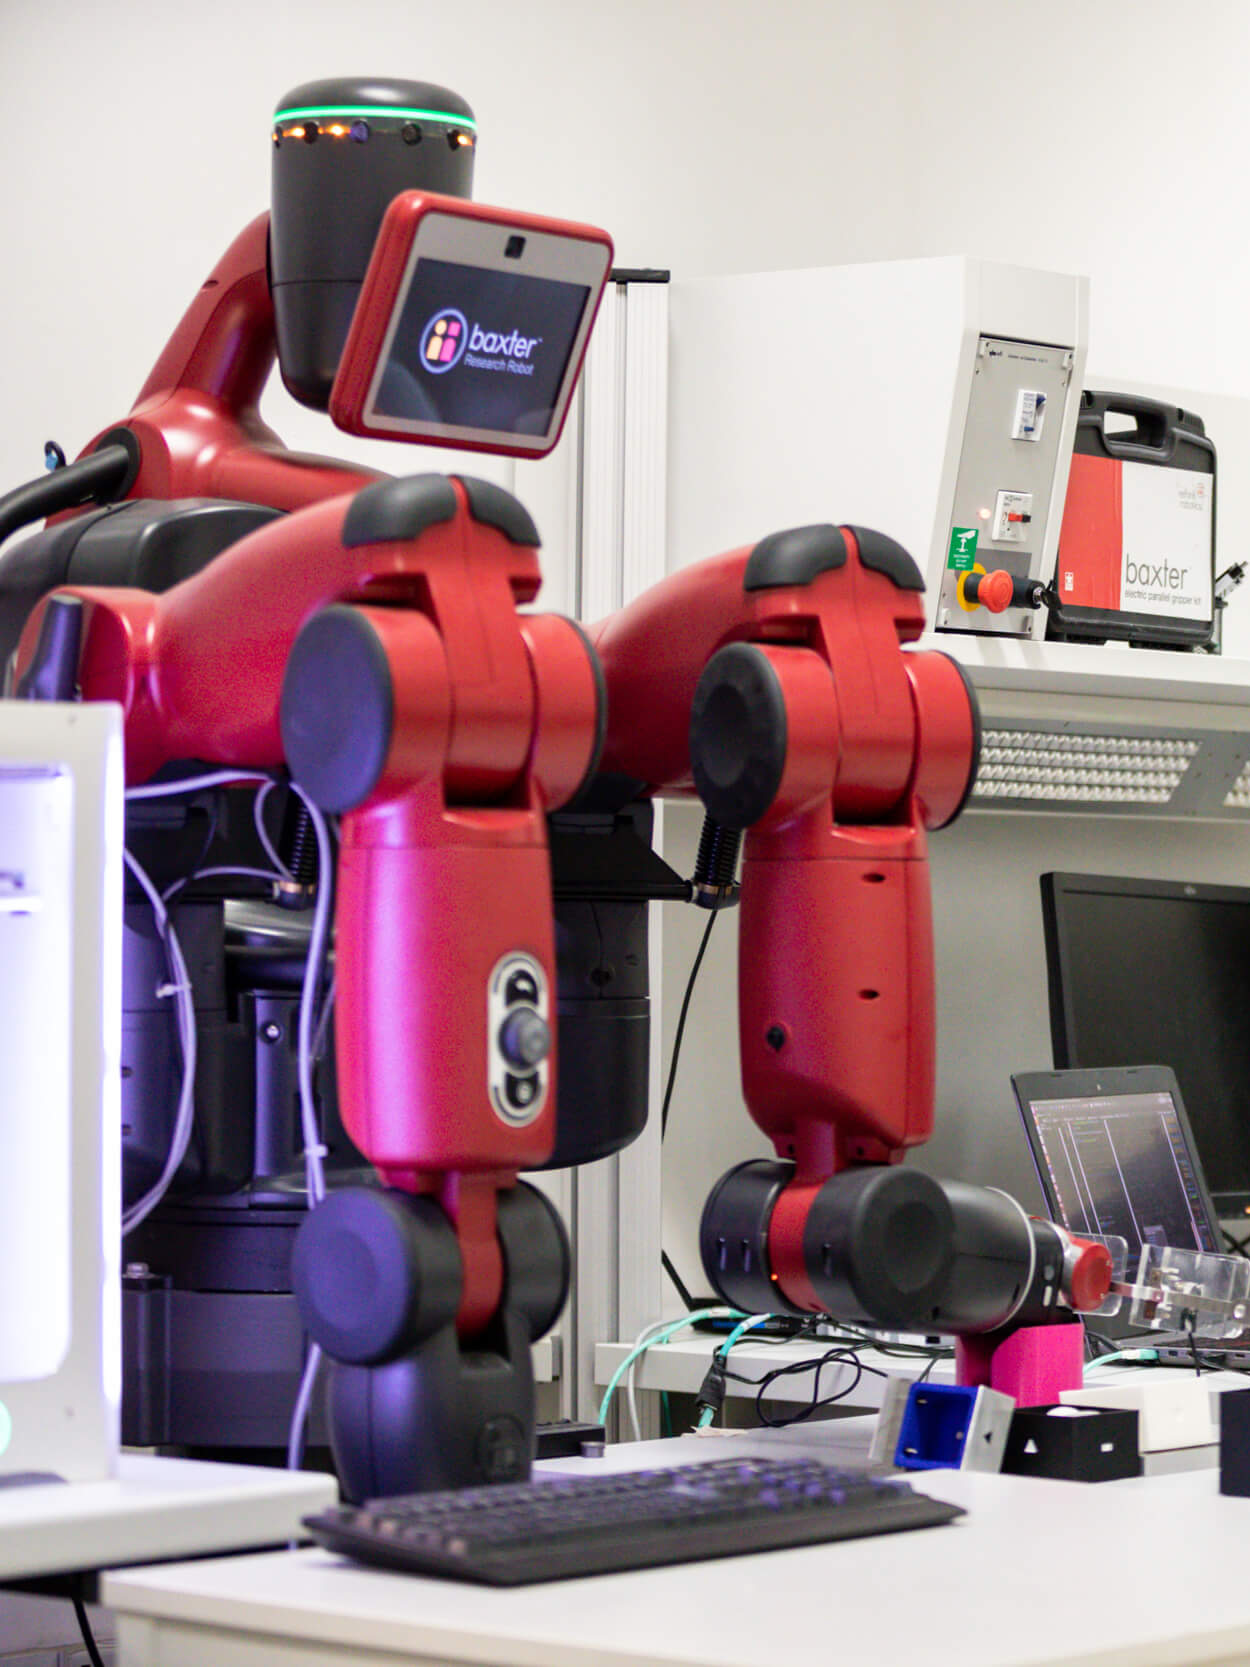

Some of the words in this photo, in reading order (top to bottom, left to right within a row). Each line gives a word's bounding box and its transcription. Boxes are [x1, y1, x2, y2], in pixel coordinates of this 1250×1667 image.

[468, 323, 537, 359] baxter
[464, 353, 506, 371] Research
[507, 359, 534, 376] Robot
[1126, 553, 1188, 590] baxter
[1125, 589, 1147, 601] electric
[1148, 591, 1170, 602] parallel
[1171, 594, 1193, 606] gripper
[1193, 596, 1201, 606] kit
